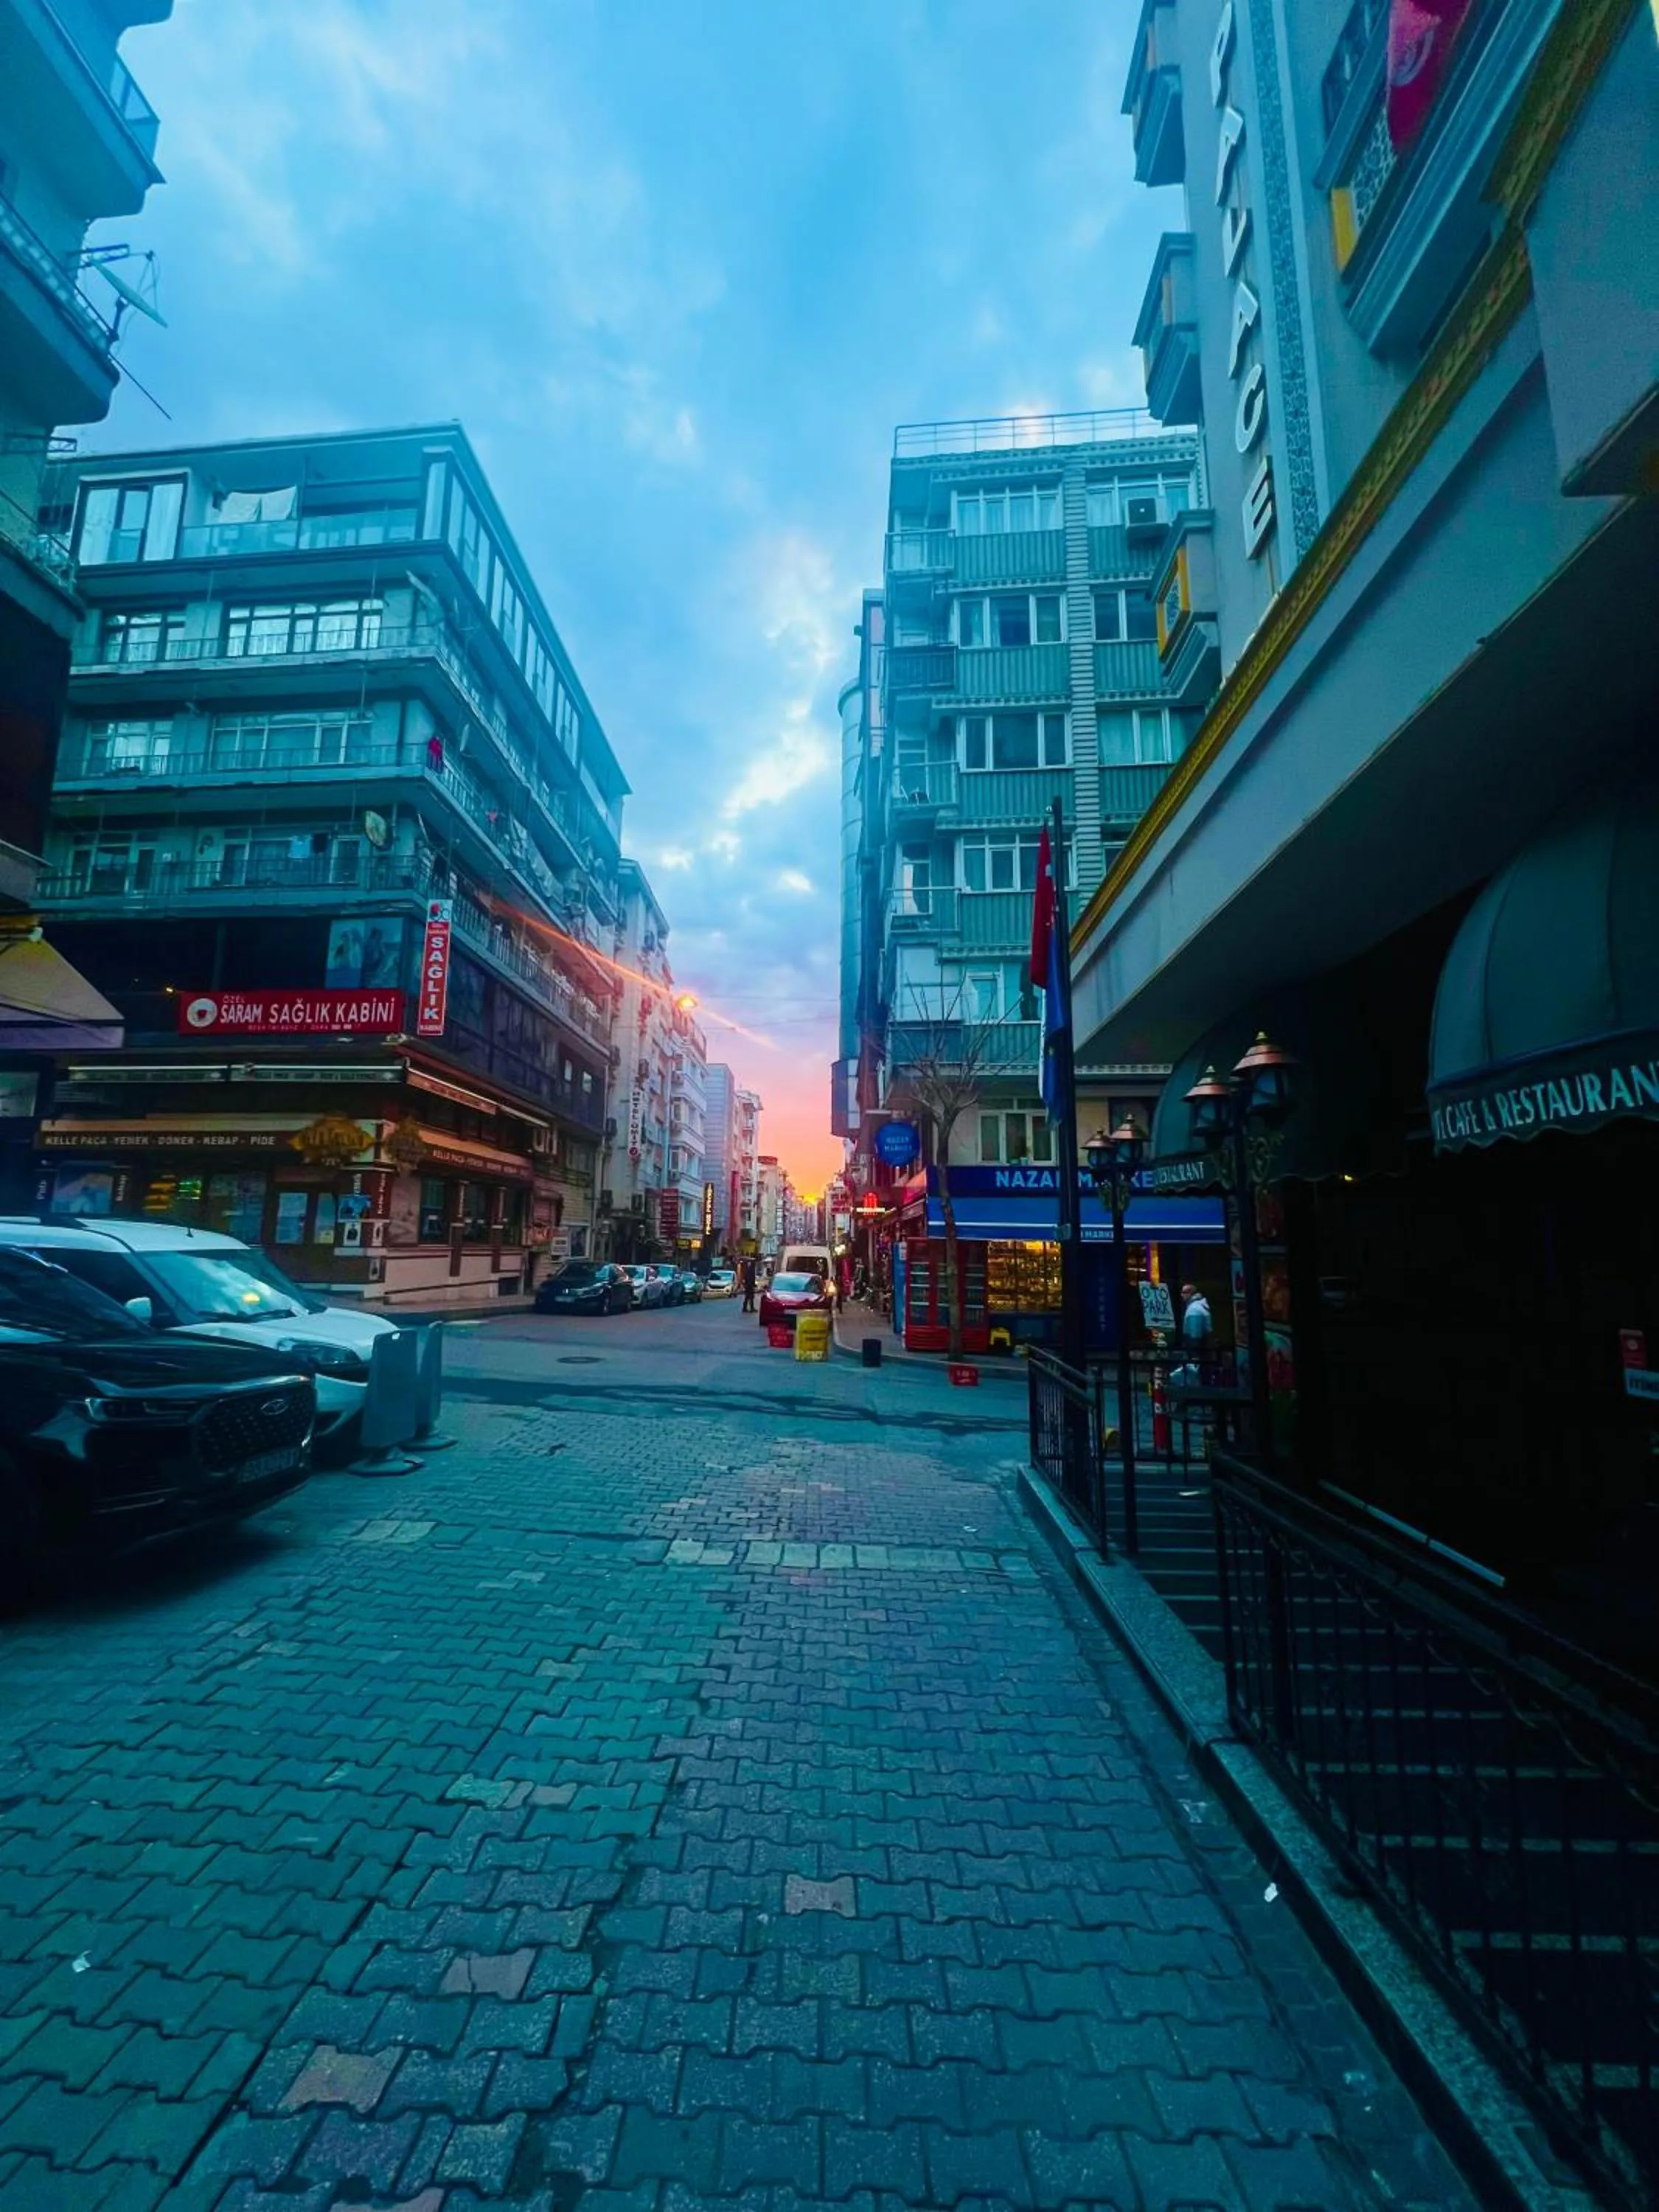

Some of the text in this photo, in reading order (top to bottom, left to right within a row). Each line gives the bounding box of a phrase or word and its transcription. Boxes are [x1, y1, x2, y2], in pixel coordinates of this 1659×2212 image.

[220, 997, 395, 1023] SARAM SAĞLIK KABİNİ
[1445, 1099, 1481, 1138] CAFE
[1494, 1060, 1659, 1129] RESTAURAN
[995, 1170, 1060, 1188] NAZA
[1142, 1287, 1169, 1300] OTO
[1144, 1300, 1169, 1315] PARK
